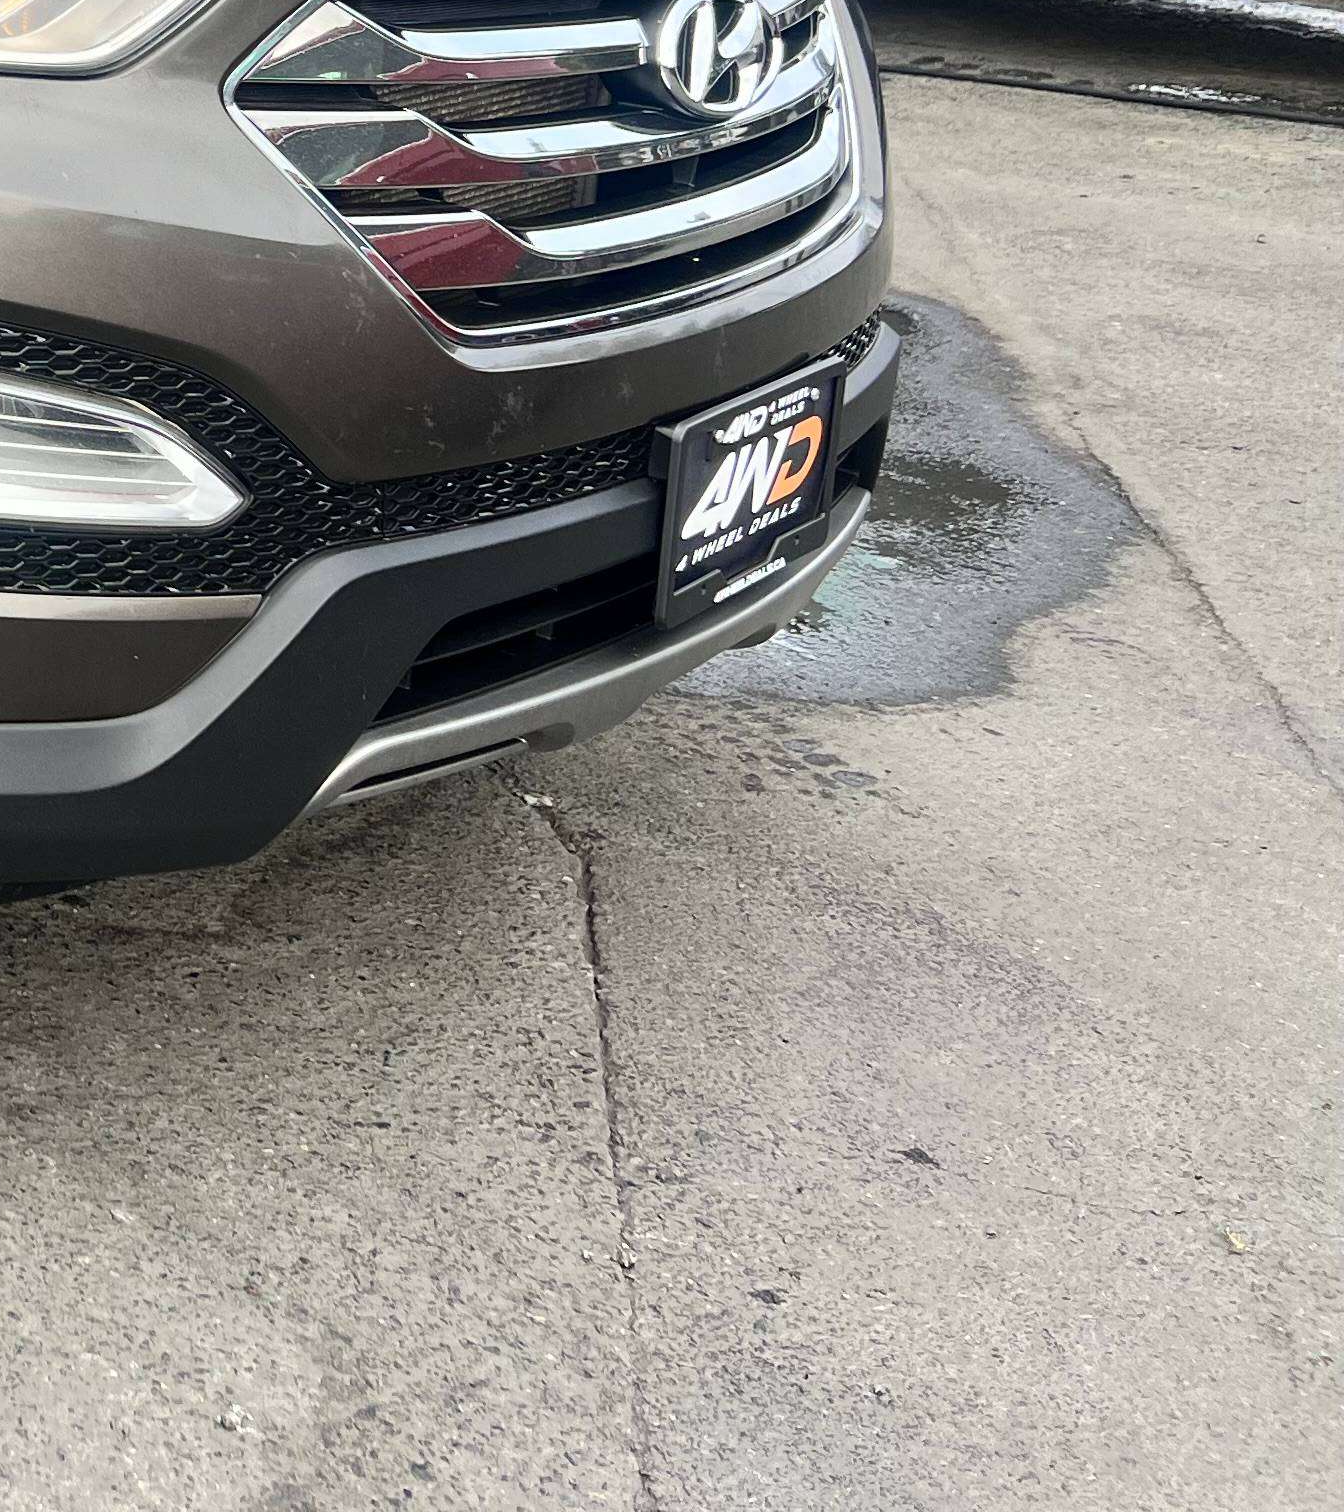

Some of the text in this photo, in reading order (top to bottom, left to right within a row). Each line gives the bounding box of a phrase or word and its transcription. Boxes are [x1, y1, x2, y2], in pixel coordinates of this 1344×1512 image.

[675, 496, 802, 572] 4 WHEEL DEALS
